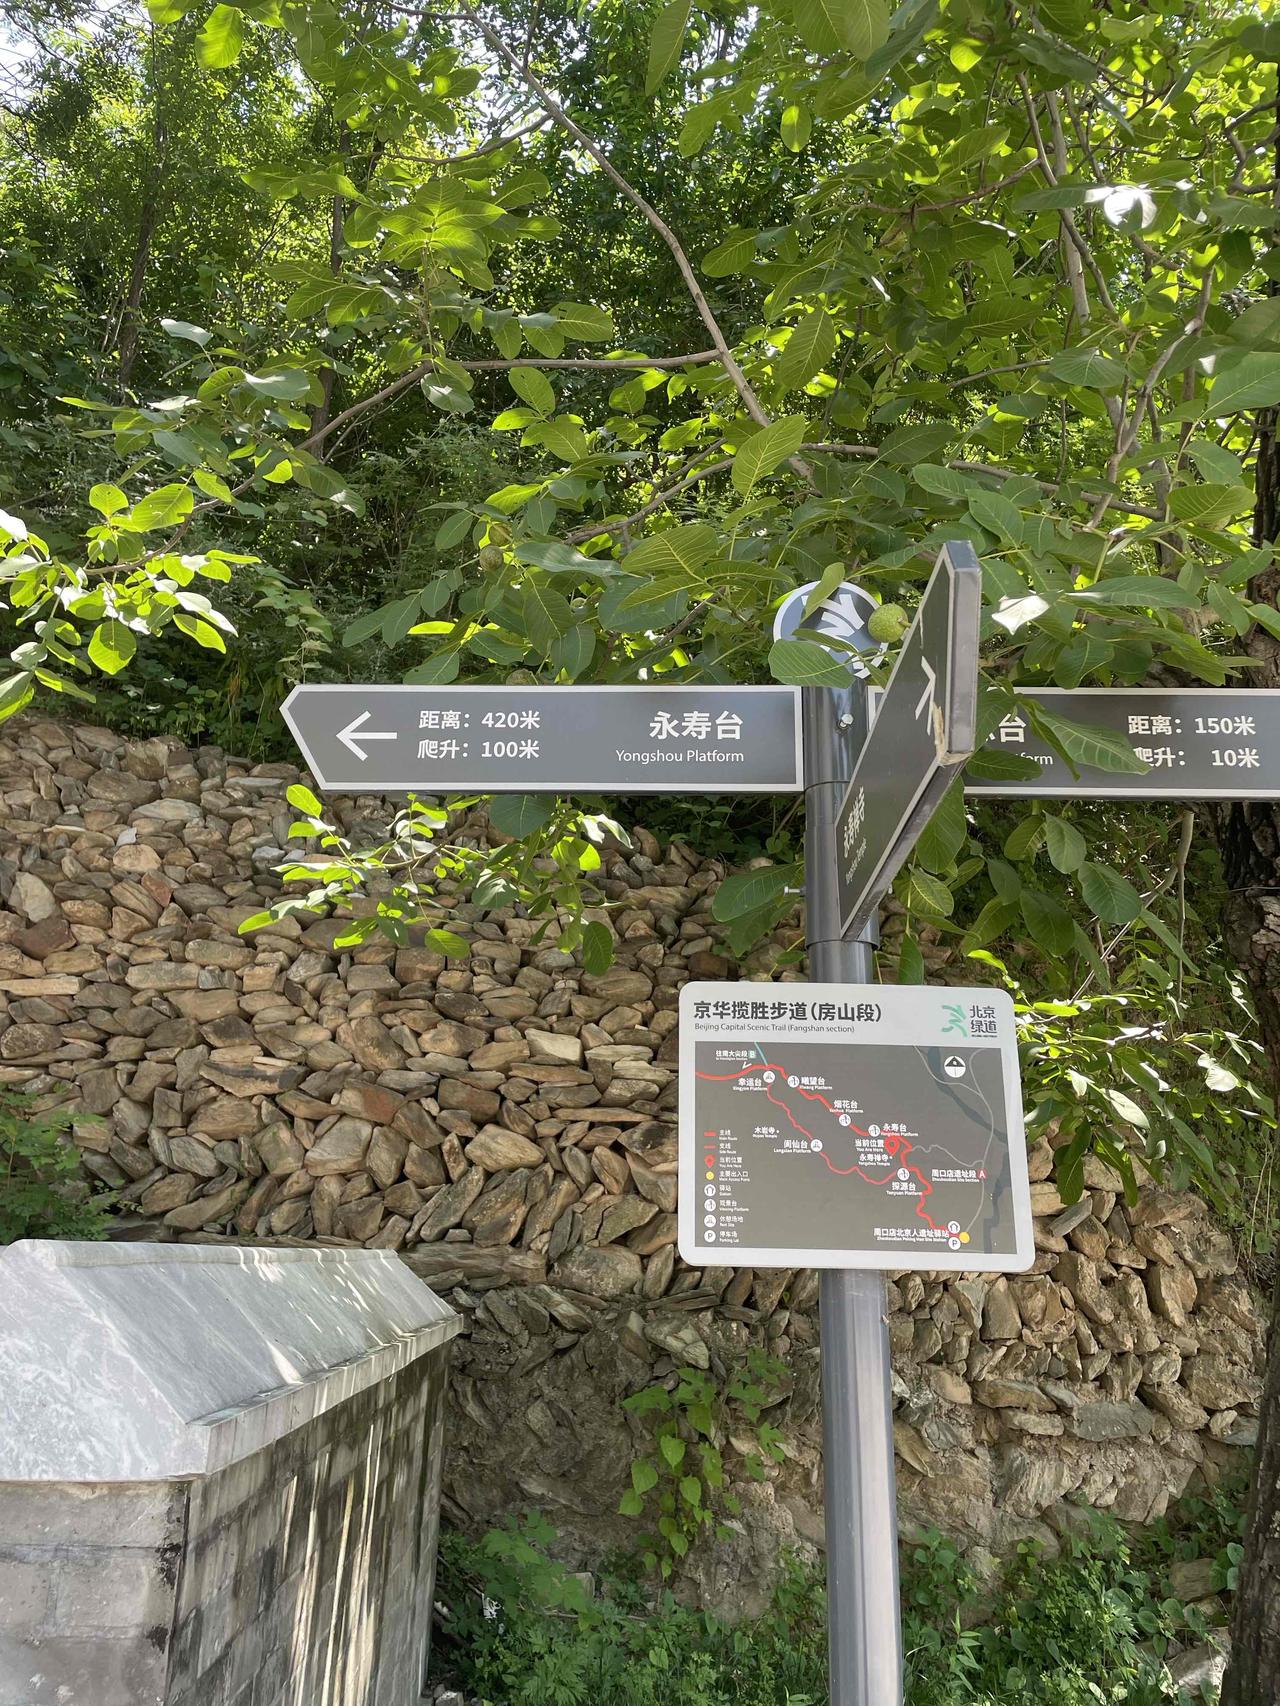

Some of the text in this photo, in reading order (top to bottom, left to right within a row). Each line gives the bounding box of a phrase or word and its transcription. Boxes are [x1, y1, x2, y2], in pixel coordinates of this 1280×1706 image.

[648, 710, 744, 740] 永寿台
[615, 749, 744, 765] Yongshou Platform
[969, 1005, 997, 1019] 北京
[694, 1023, 855, 1033] Beijing Capital Scenic Trail (Fangshan section)
[970, 1019, 998, 1034] 绿道
[856, 1139, 884, 1148] 当前位置
[932, 1169, 976, 1179] 周口店遗址段
